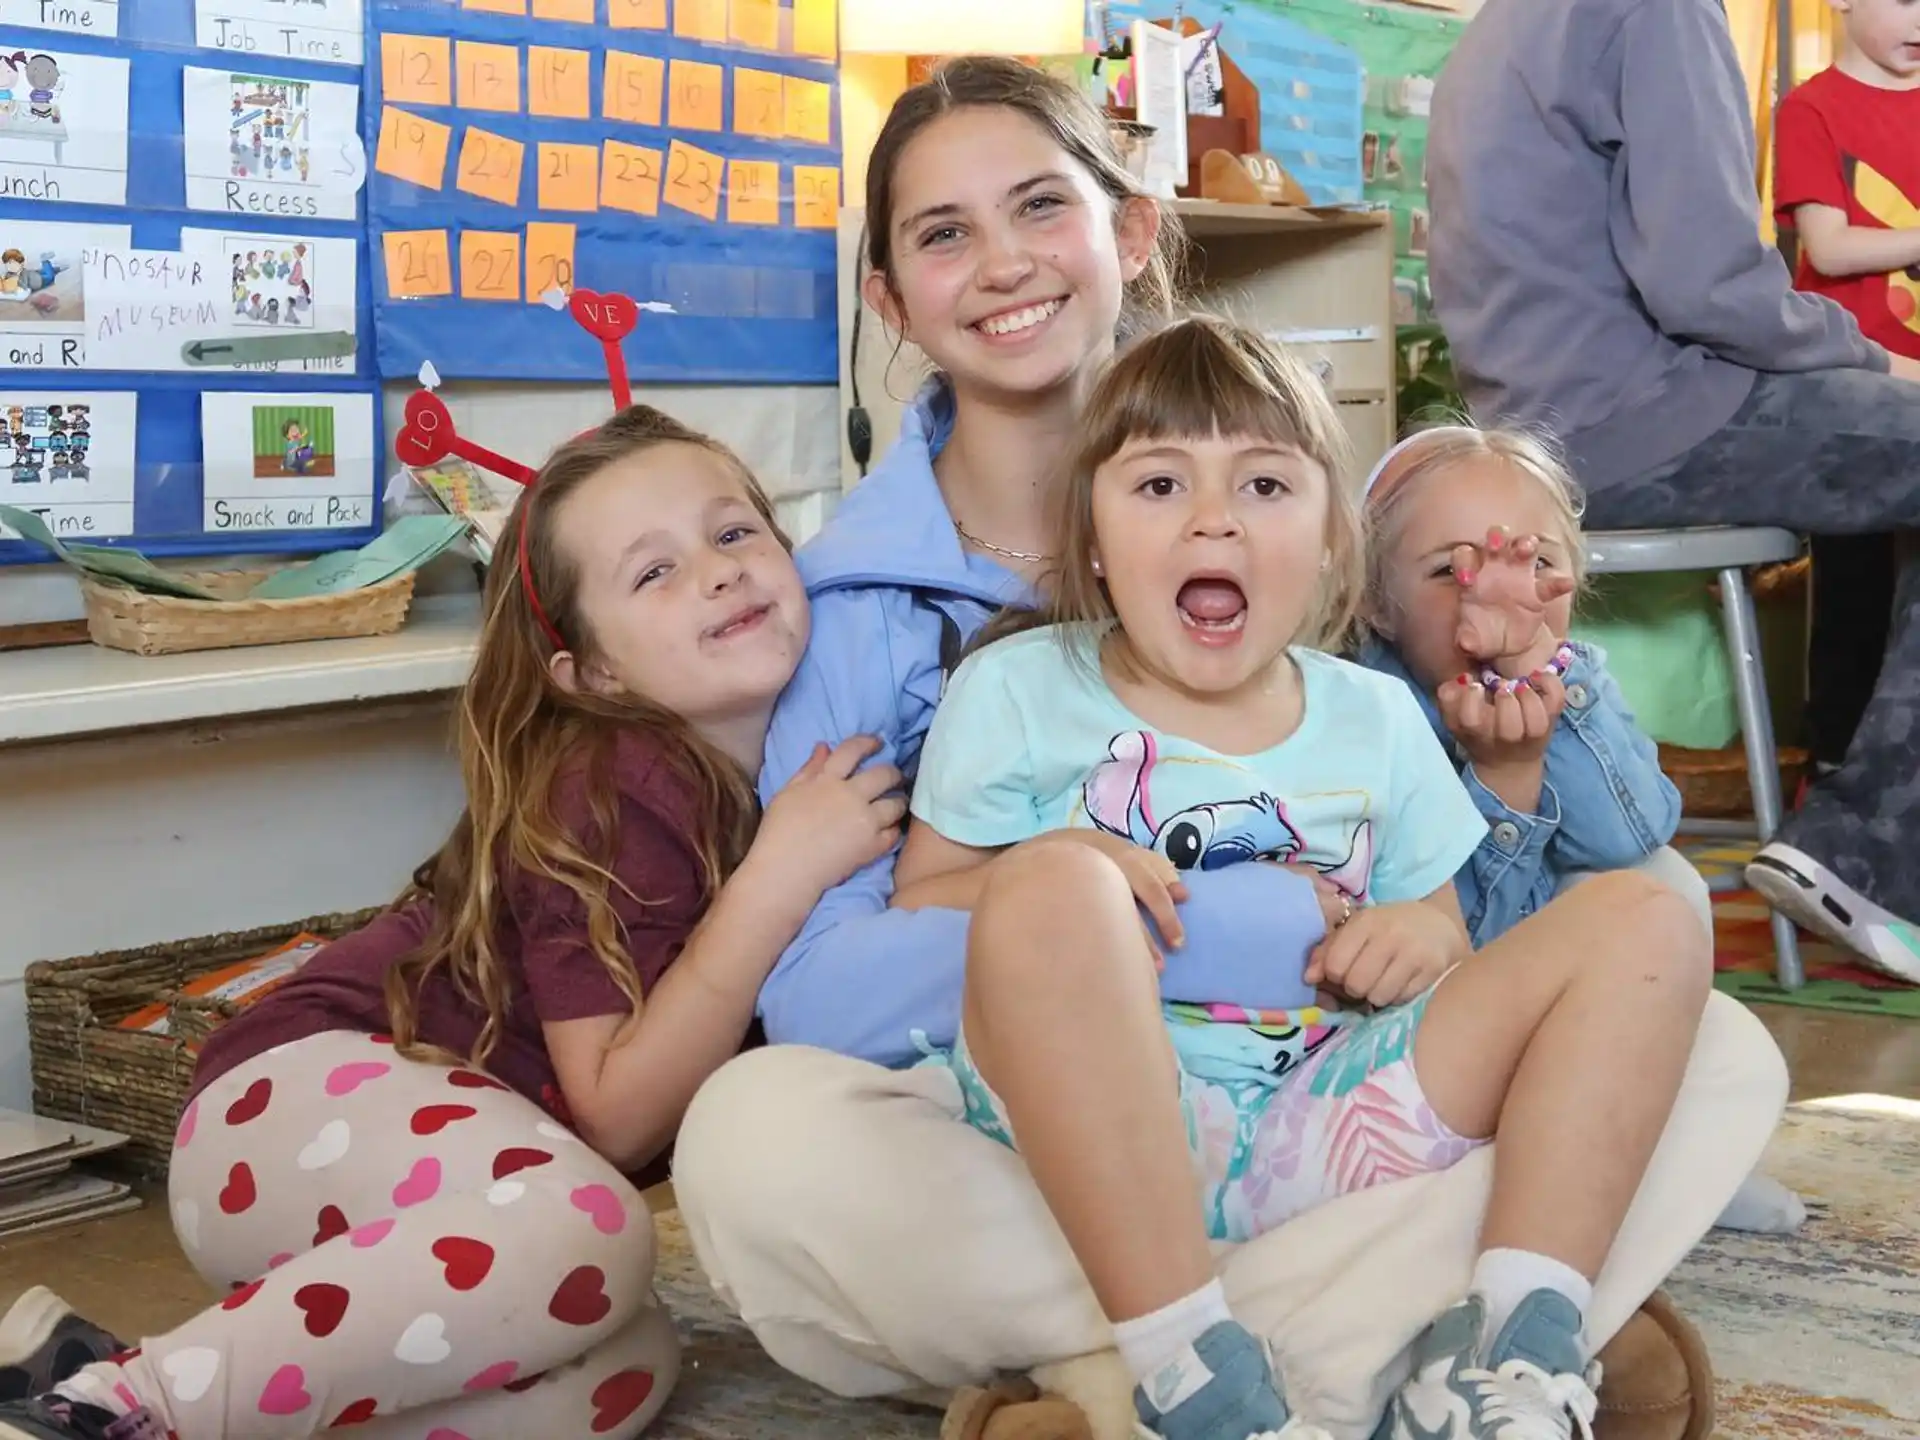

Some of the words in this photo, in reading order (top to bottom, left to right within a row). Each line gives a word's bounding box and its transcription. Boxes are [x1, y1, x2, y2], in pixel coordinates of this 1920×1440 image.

[36, 0, 93, 26] Time
[213, 18, 256, 50] Job
[279, 29, 342, 58] Time
[400, 46, 438, 86] 12
[472, 62, 502, 99] 13
[394, 118, 426, 155] 19
[548, 151, 570, 178] 21
[614, 154, 658, 182] 22
[671, 149, 714, 204] 23
[225, 181, 318, 216] Recess
[398, 238, 440, 291] 26
[471, 248, 515, 292] 27
[98, 300, 217, 341] MUSEUM
[10, 343, 43, 365] and
[215, 500, 275, 528] Snack
[287, 501, 314, 525] and
[327, 496, 362, 526] Pack
